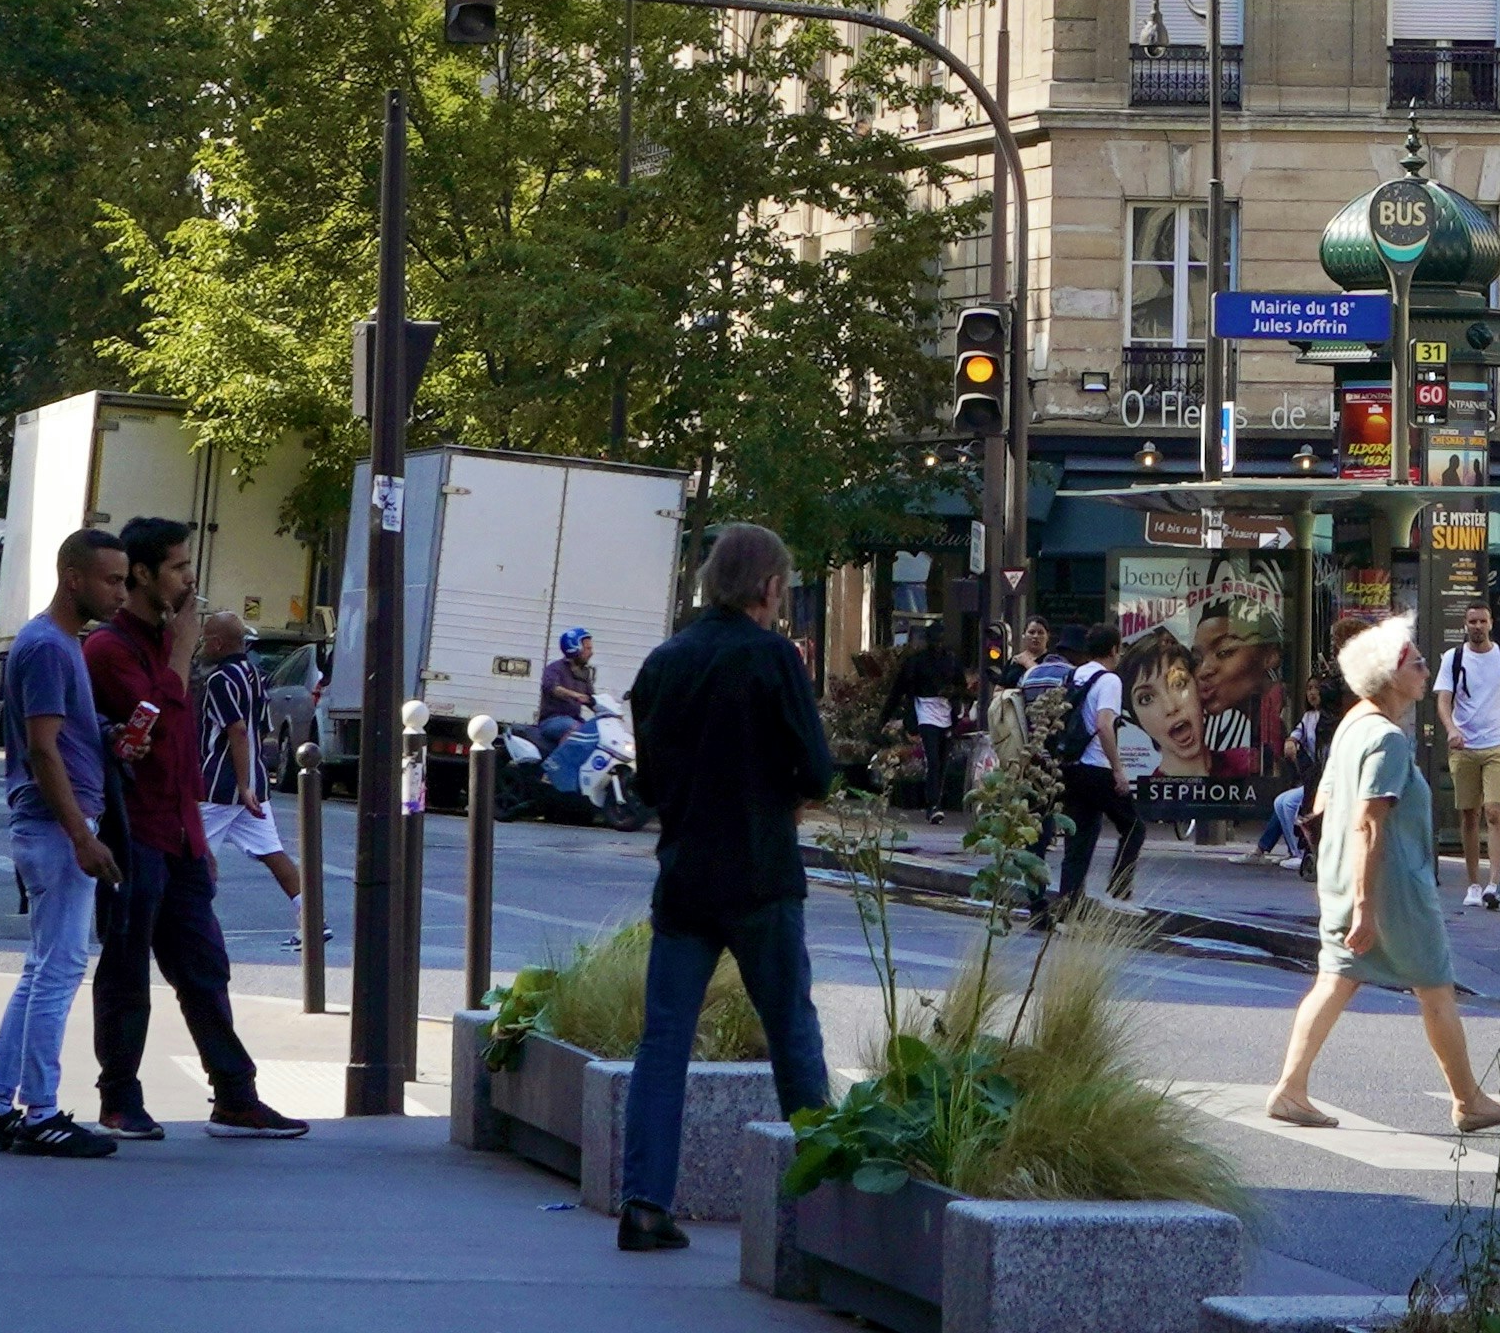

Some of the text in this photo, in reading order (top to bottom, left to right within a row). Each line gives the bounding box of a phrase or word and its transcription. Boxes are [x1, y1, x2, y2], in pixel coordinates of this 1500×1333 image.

[1379, 201, 1427, 226] BUS
[1250, 299, 1301, 315] Mairie
[1305, 300, 1326, 316] du
[1253, 318, 1347, 334] Jules Joffrin
[1421, 344, 1441, 360] 31
[1419, 386, 1443, 403] 60
[1271, 392, 1306, 429] de
[1432, 509, 1486, 527] LE MYSTÈRE
[1154, 521, 1164, 532] 14
[1167, 522, 1180, 533] bis
[1183, 525, 1198, 535] rue
[1432, 526, 1486, 550] SUNNY
[1124, 565, 1201, 592] benefit
[1150, 784, 1257, 801] SEPHORA
